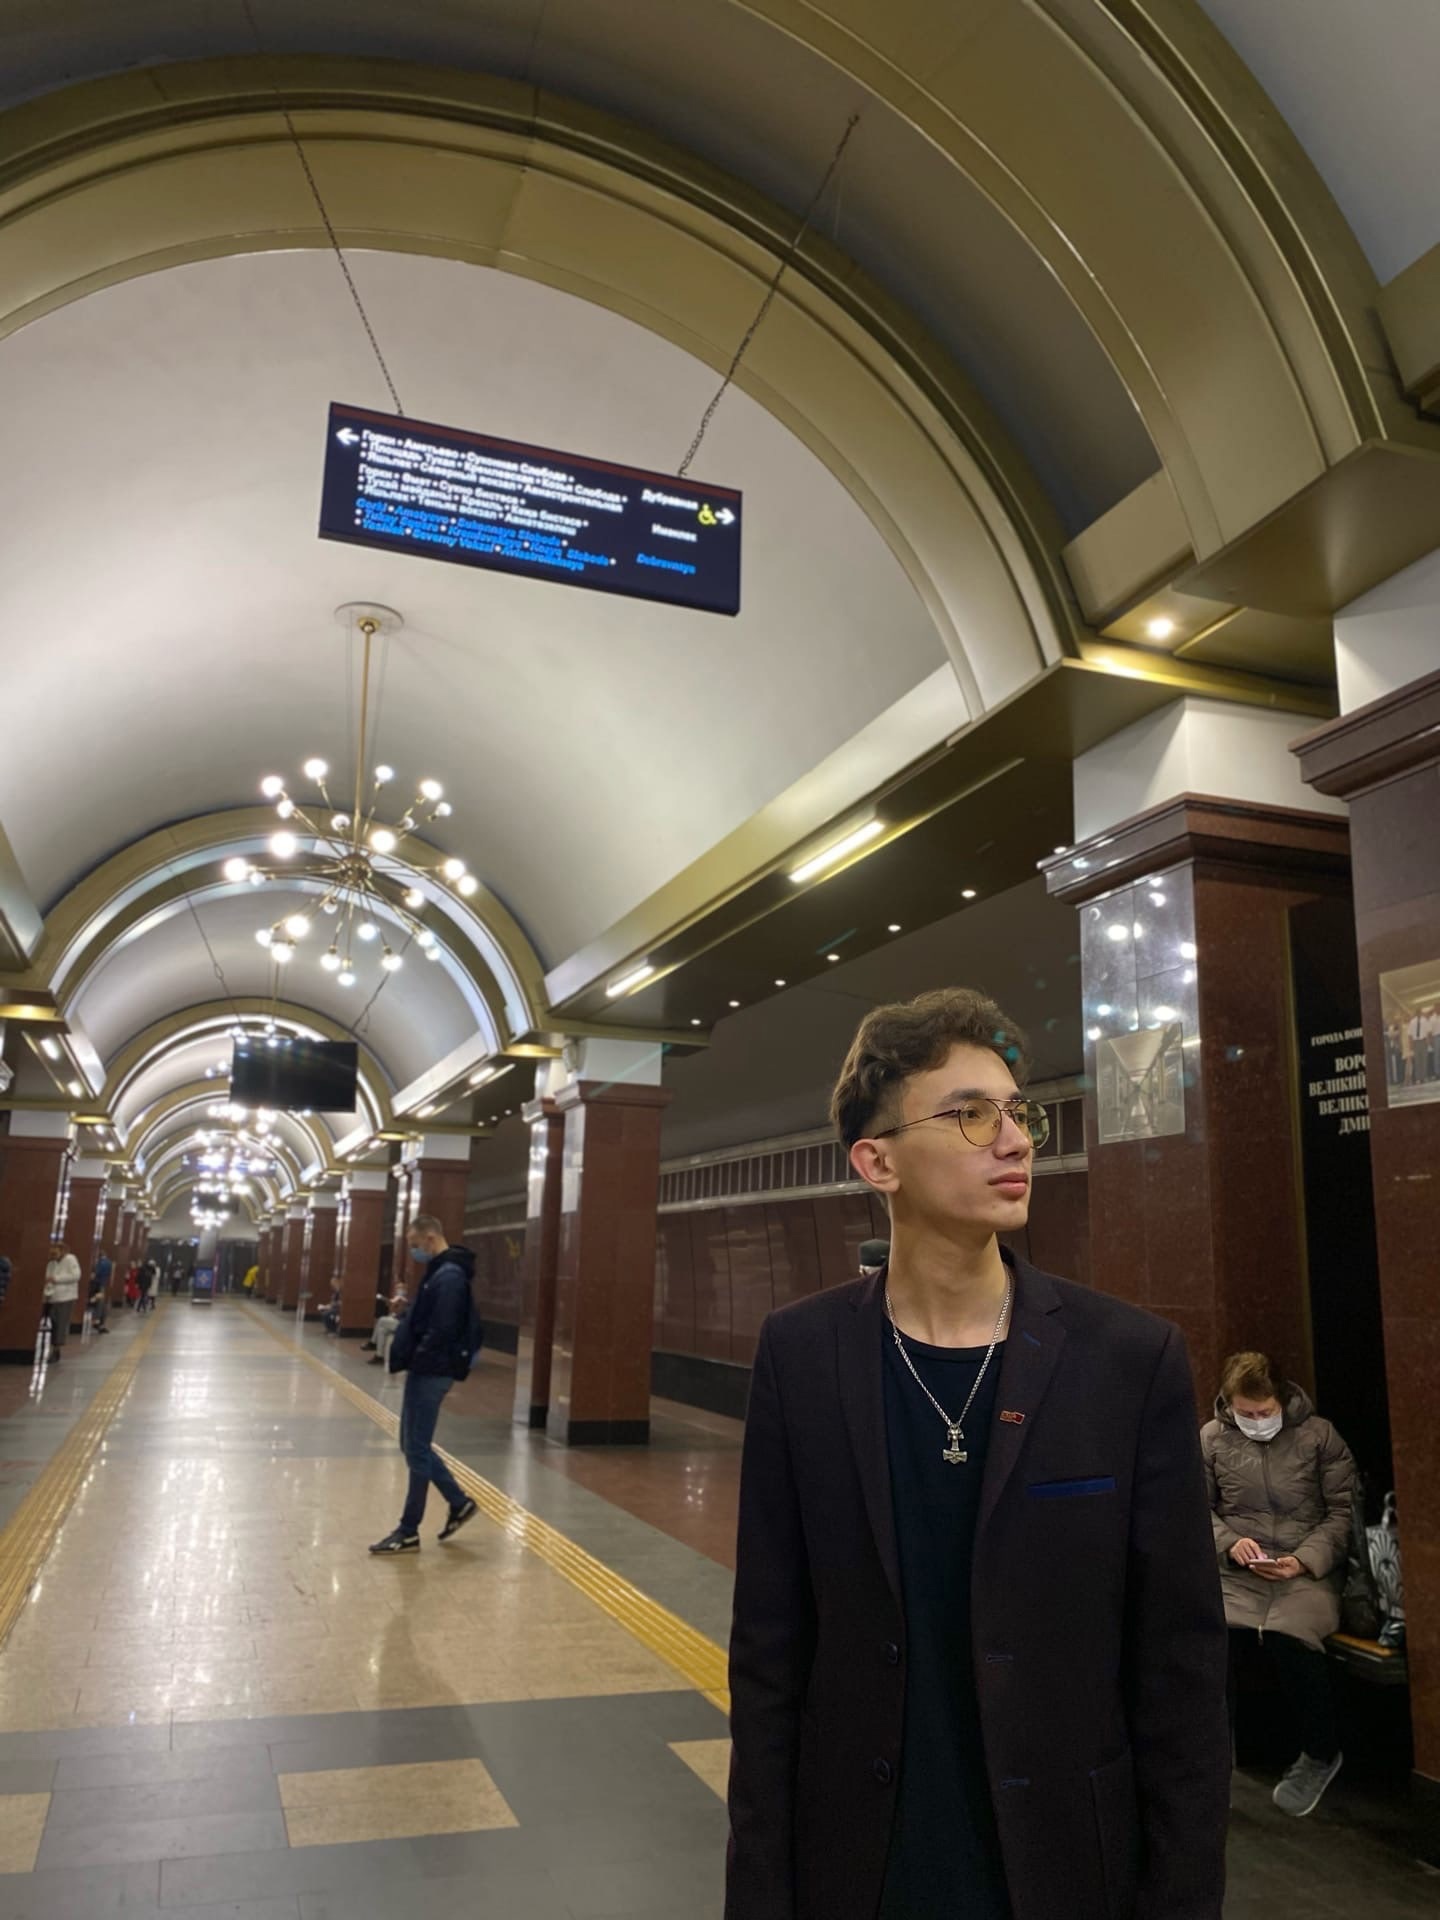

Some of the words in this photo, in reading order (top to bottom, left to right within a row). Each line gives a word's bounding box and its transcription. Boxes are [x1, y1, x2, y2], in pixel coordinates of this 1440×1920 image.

[478, 474, 517, 491] вокзал
[574, 484, 621, 504] Слобода
[1311, 1033, 1344, 1046] ГОРОДА
[1309, 1071, 1366, 1097] ВЕЛИКИЙ
